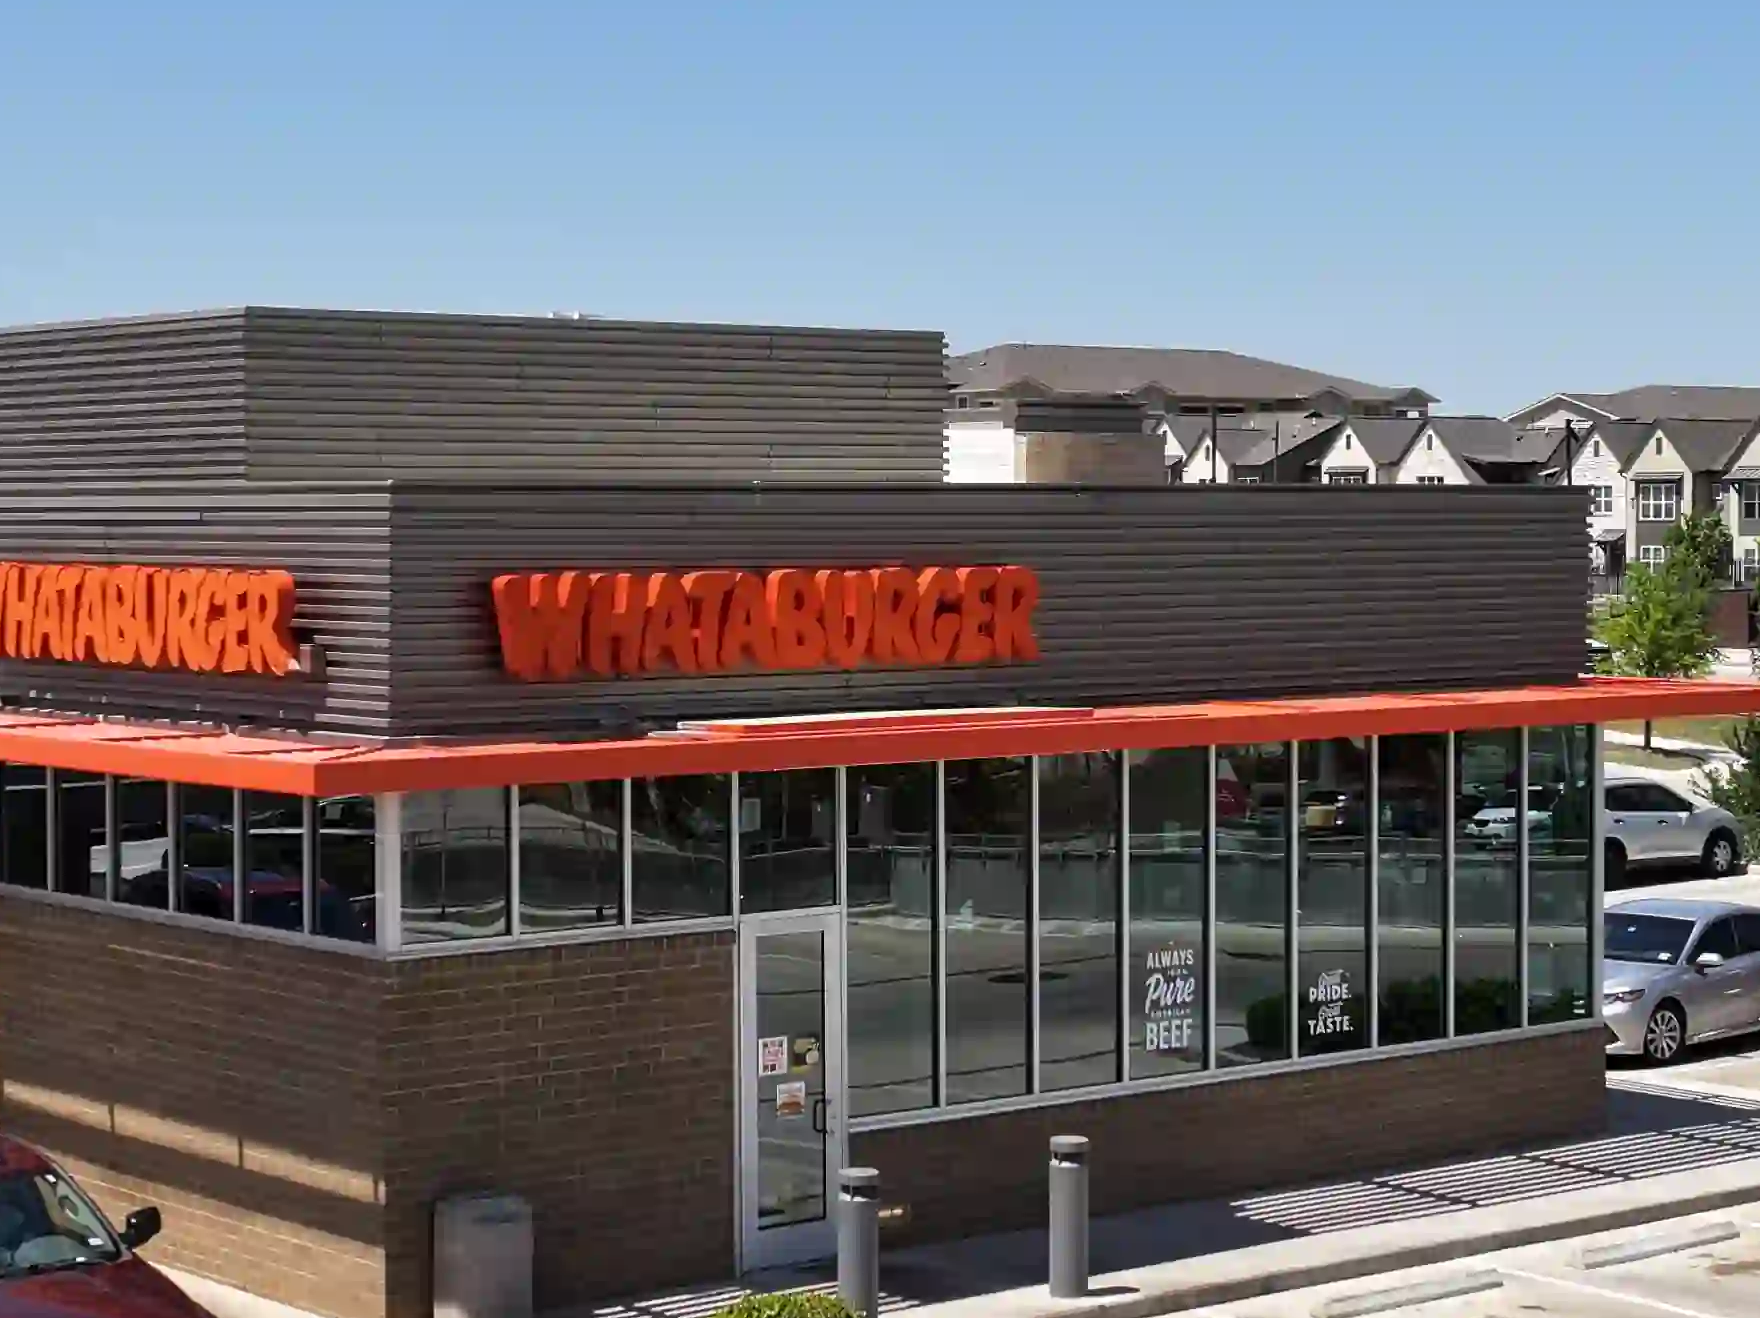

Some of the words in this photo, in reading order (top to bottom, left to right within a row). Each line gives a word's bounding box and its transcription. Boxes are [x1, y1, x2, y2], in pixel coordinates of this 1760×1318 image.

[492, 566, 1038, 680] WHATABURGER
[1146, 949, 1194, 969] ALWAYS
[1144, 972, 1196, 1014] Pure
[1145, 1018, 1193, 1052] BEEF
